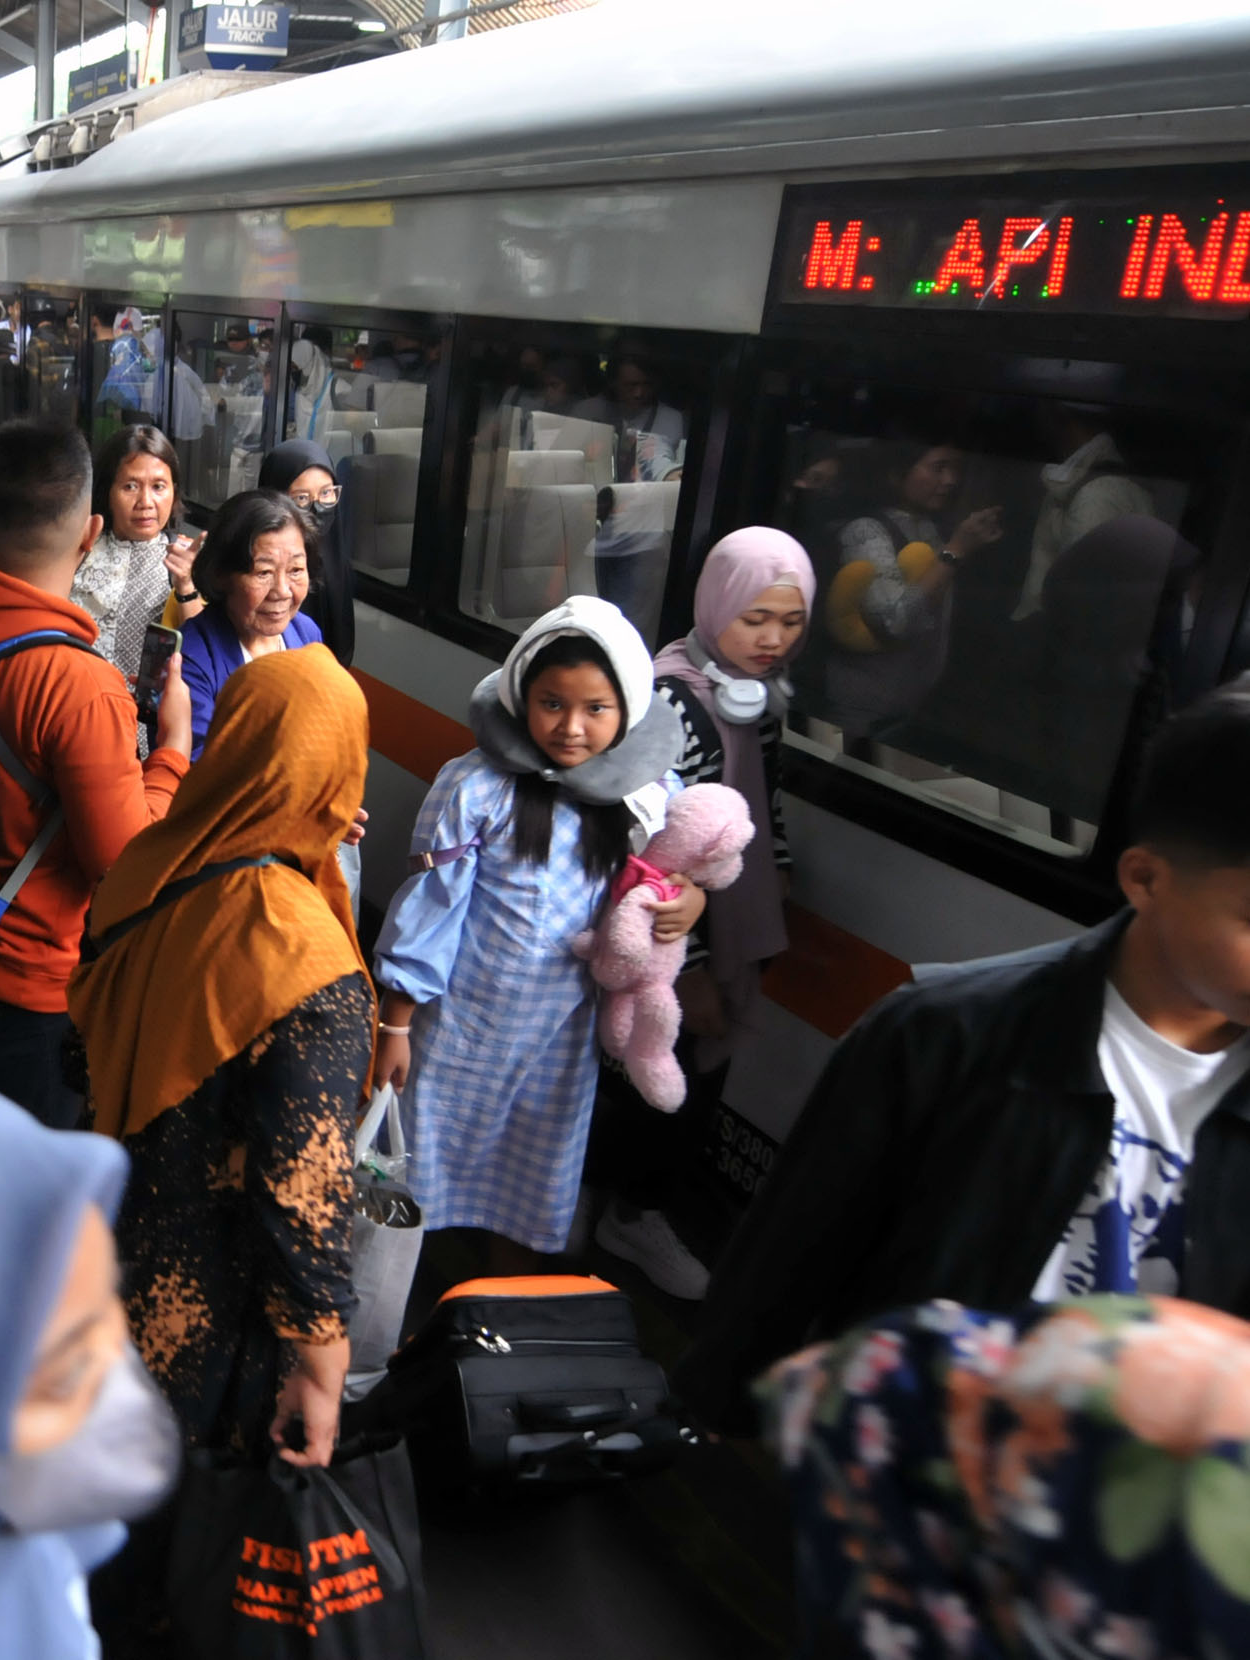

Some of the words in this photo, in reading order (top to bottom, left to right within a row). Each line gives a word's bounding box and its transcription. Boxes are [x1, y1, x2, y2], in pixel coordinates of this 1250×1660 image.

[217, 7, 278, 29] JALUR
[228, 30, 266, 43] TRACK
[933, 216, 1074, 298] API
